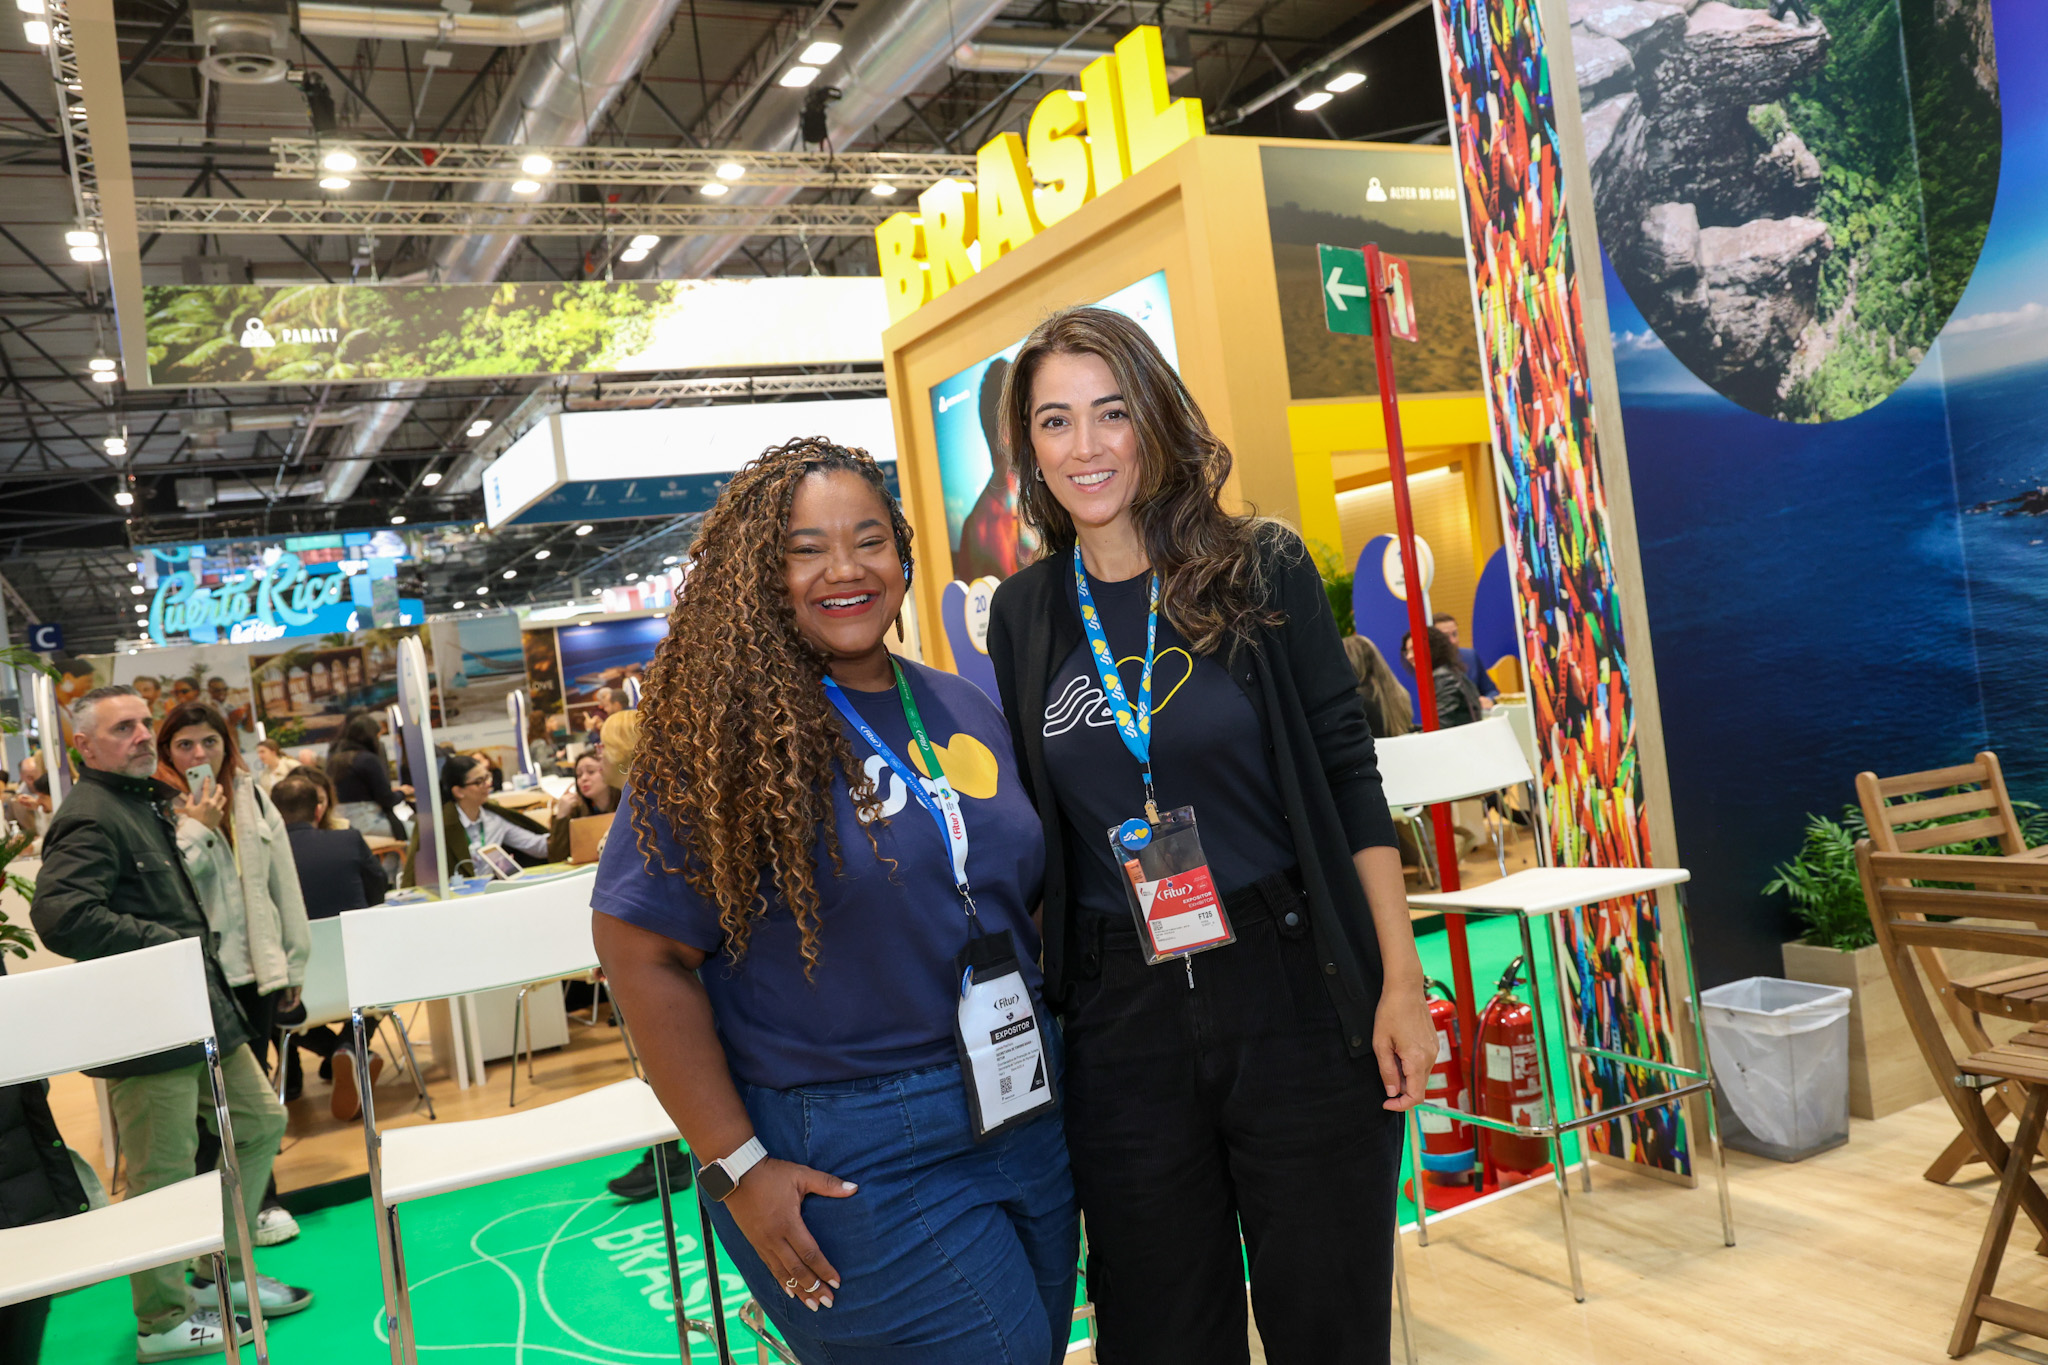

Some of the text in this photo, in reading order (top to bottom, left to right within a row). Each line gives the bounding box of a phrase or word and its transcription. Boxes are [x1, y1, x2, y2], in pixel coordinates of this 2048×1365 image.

[875, 25, 1206, 326] BRASIL
[1390, 186, 1417, 200] ALTER
[1418, 186, 1431, 201] DO
[281, 327, 338, 343] PARATY
[149, 552, 346, 647] Puerto Rico
[974, 594, 987, 613] 20
[36, 626, 57, 649] C
[1182, 891, 1212, 904] EXPOSITOR
[1188, 896, 1214, 908] EXHIBITOR
[1197, 910, 1213, 920] FT25
[994, 1020, 1030, 1041] EXPOSITOR
